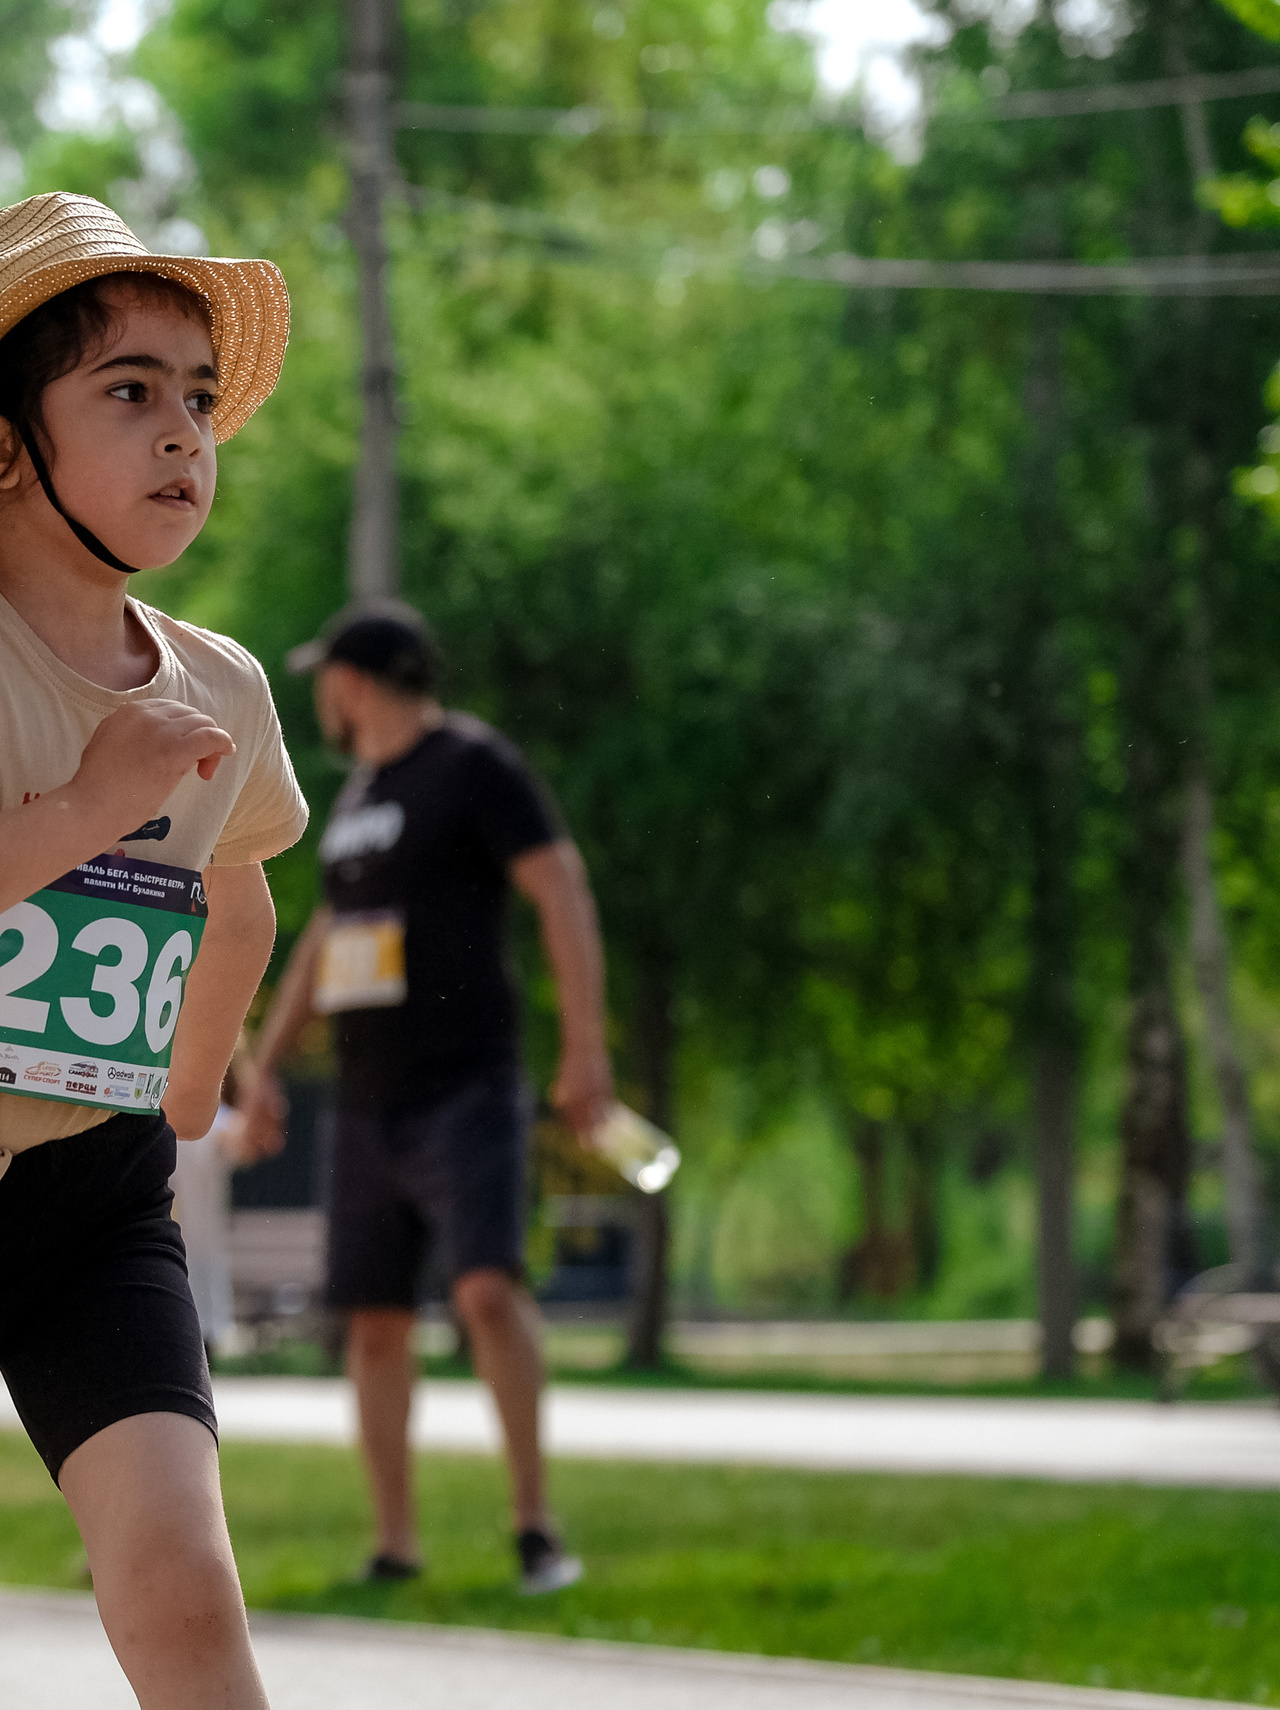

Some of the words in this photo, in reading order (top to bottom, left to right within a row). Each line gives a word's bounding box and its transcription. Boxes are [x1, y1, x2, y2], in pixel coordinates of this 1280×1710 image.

[76, 863, 105, 875] ИВАЛЬ
[107, 868, 129, 880] БЕГА
[84, 878, 116, 889] памяти
[118, 882, 132, 892] Н.Г
[132, 885, 165, 898] Булакина
[24, 1074, 43, 1082] СУПЕР
[42, 1077, 61, 1085] СПОРТ
[66, 1080, 98, 1092] перцы
